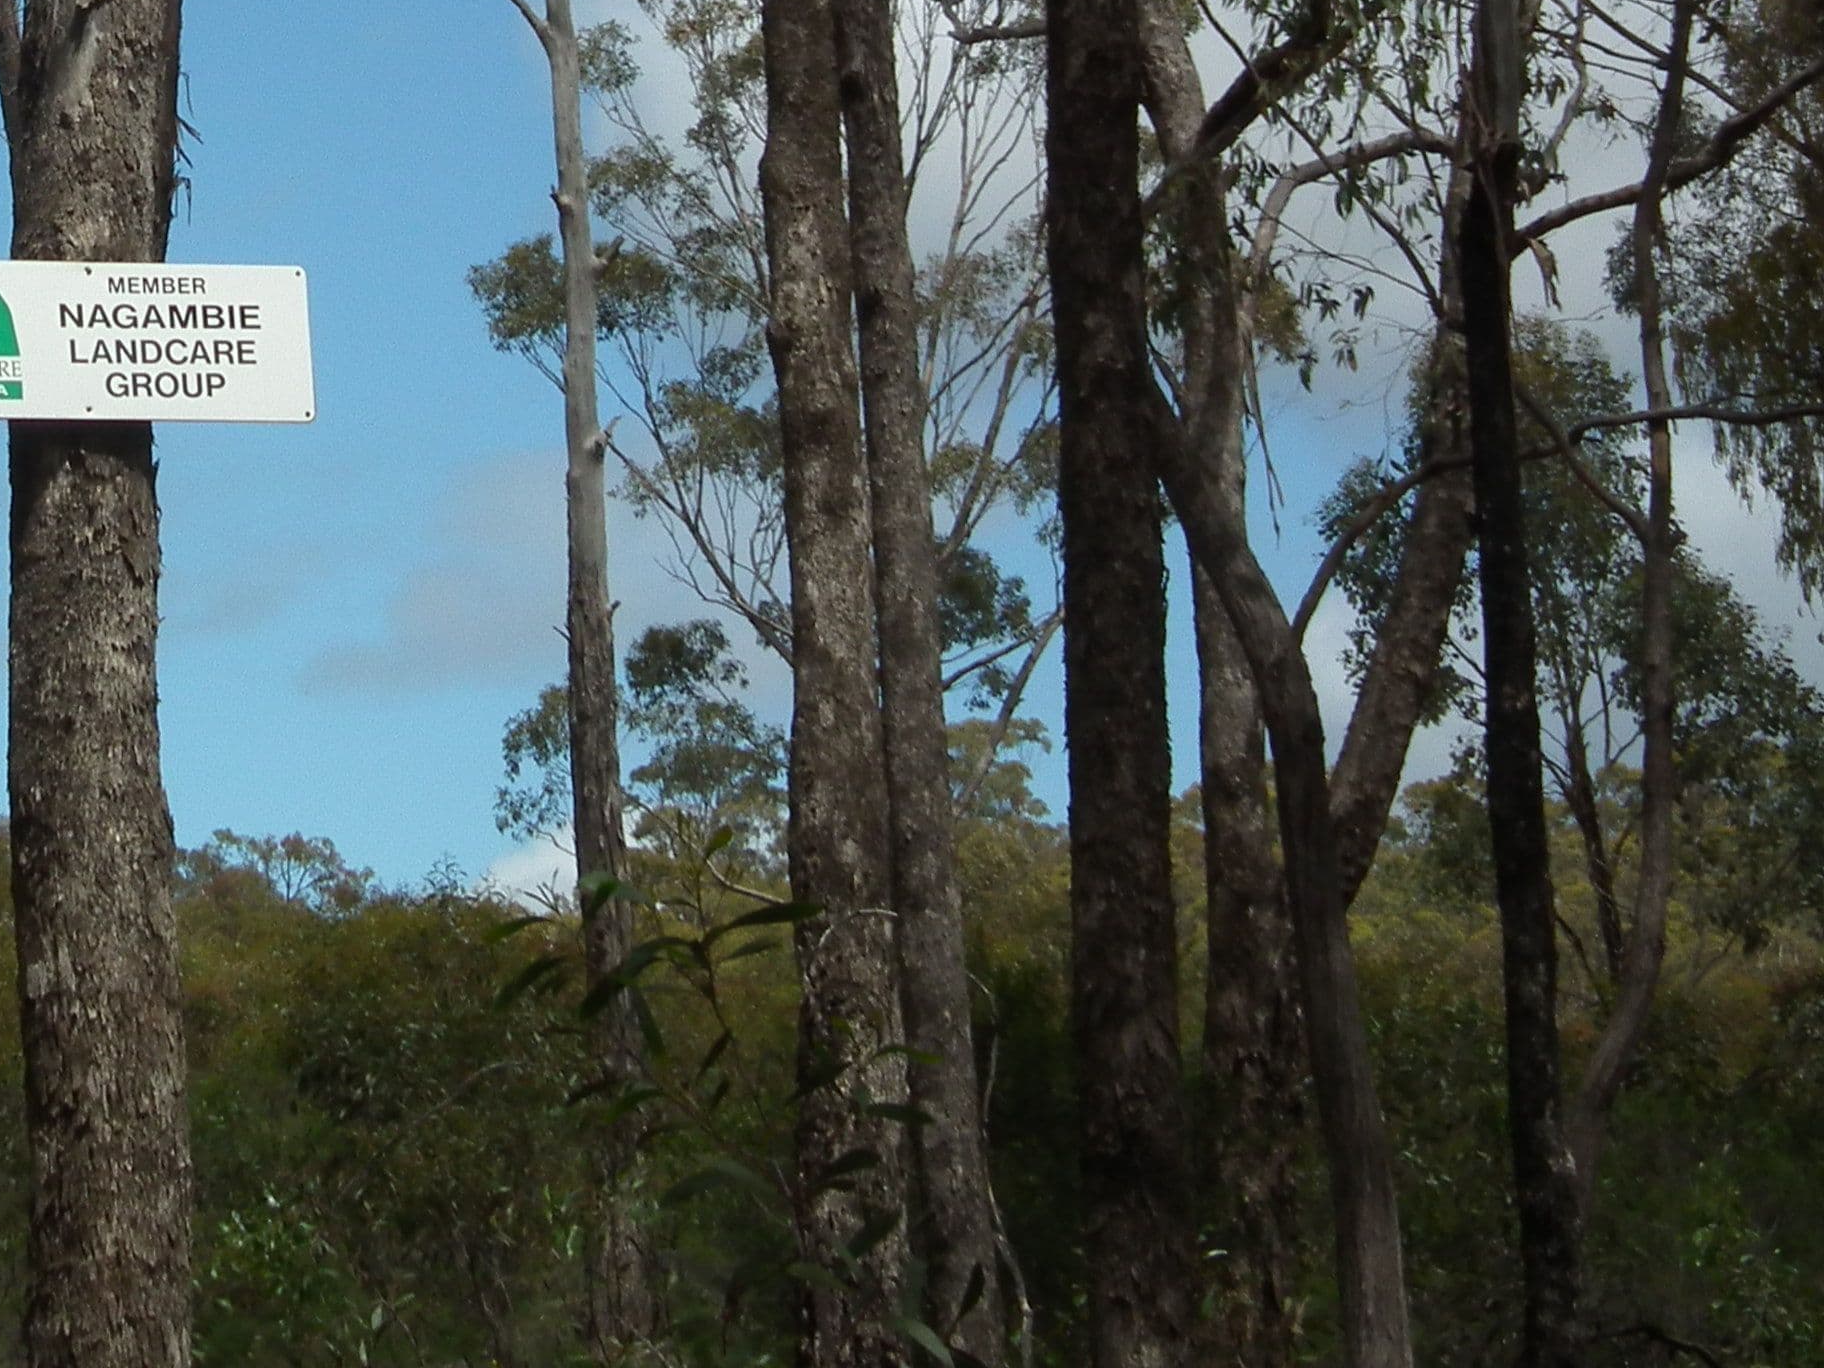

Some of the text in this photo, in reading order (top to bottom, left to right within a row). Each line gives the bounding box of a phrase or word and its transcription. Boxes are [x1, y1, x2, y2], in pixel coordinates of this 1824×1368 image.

[107, 276, 207, 295] MEMBER
[58, 303, 262, 330] NAGAMBIE
[69, 338, 258, 365] LANDCARE
[104, 372, 227, 398] GROUP
